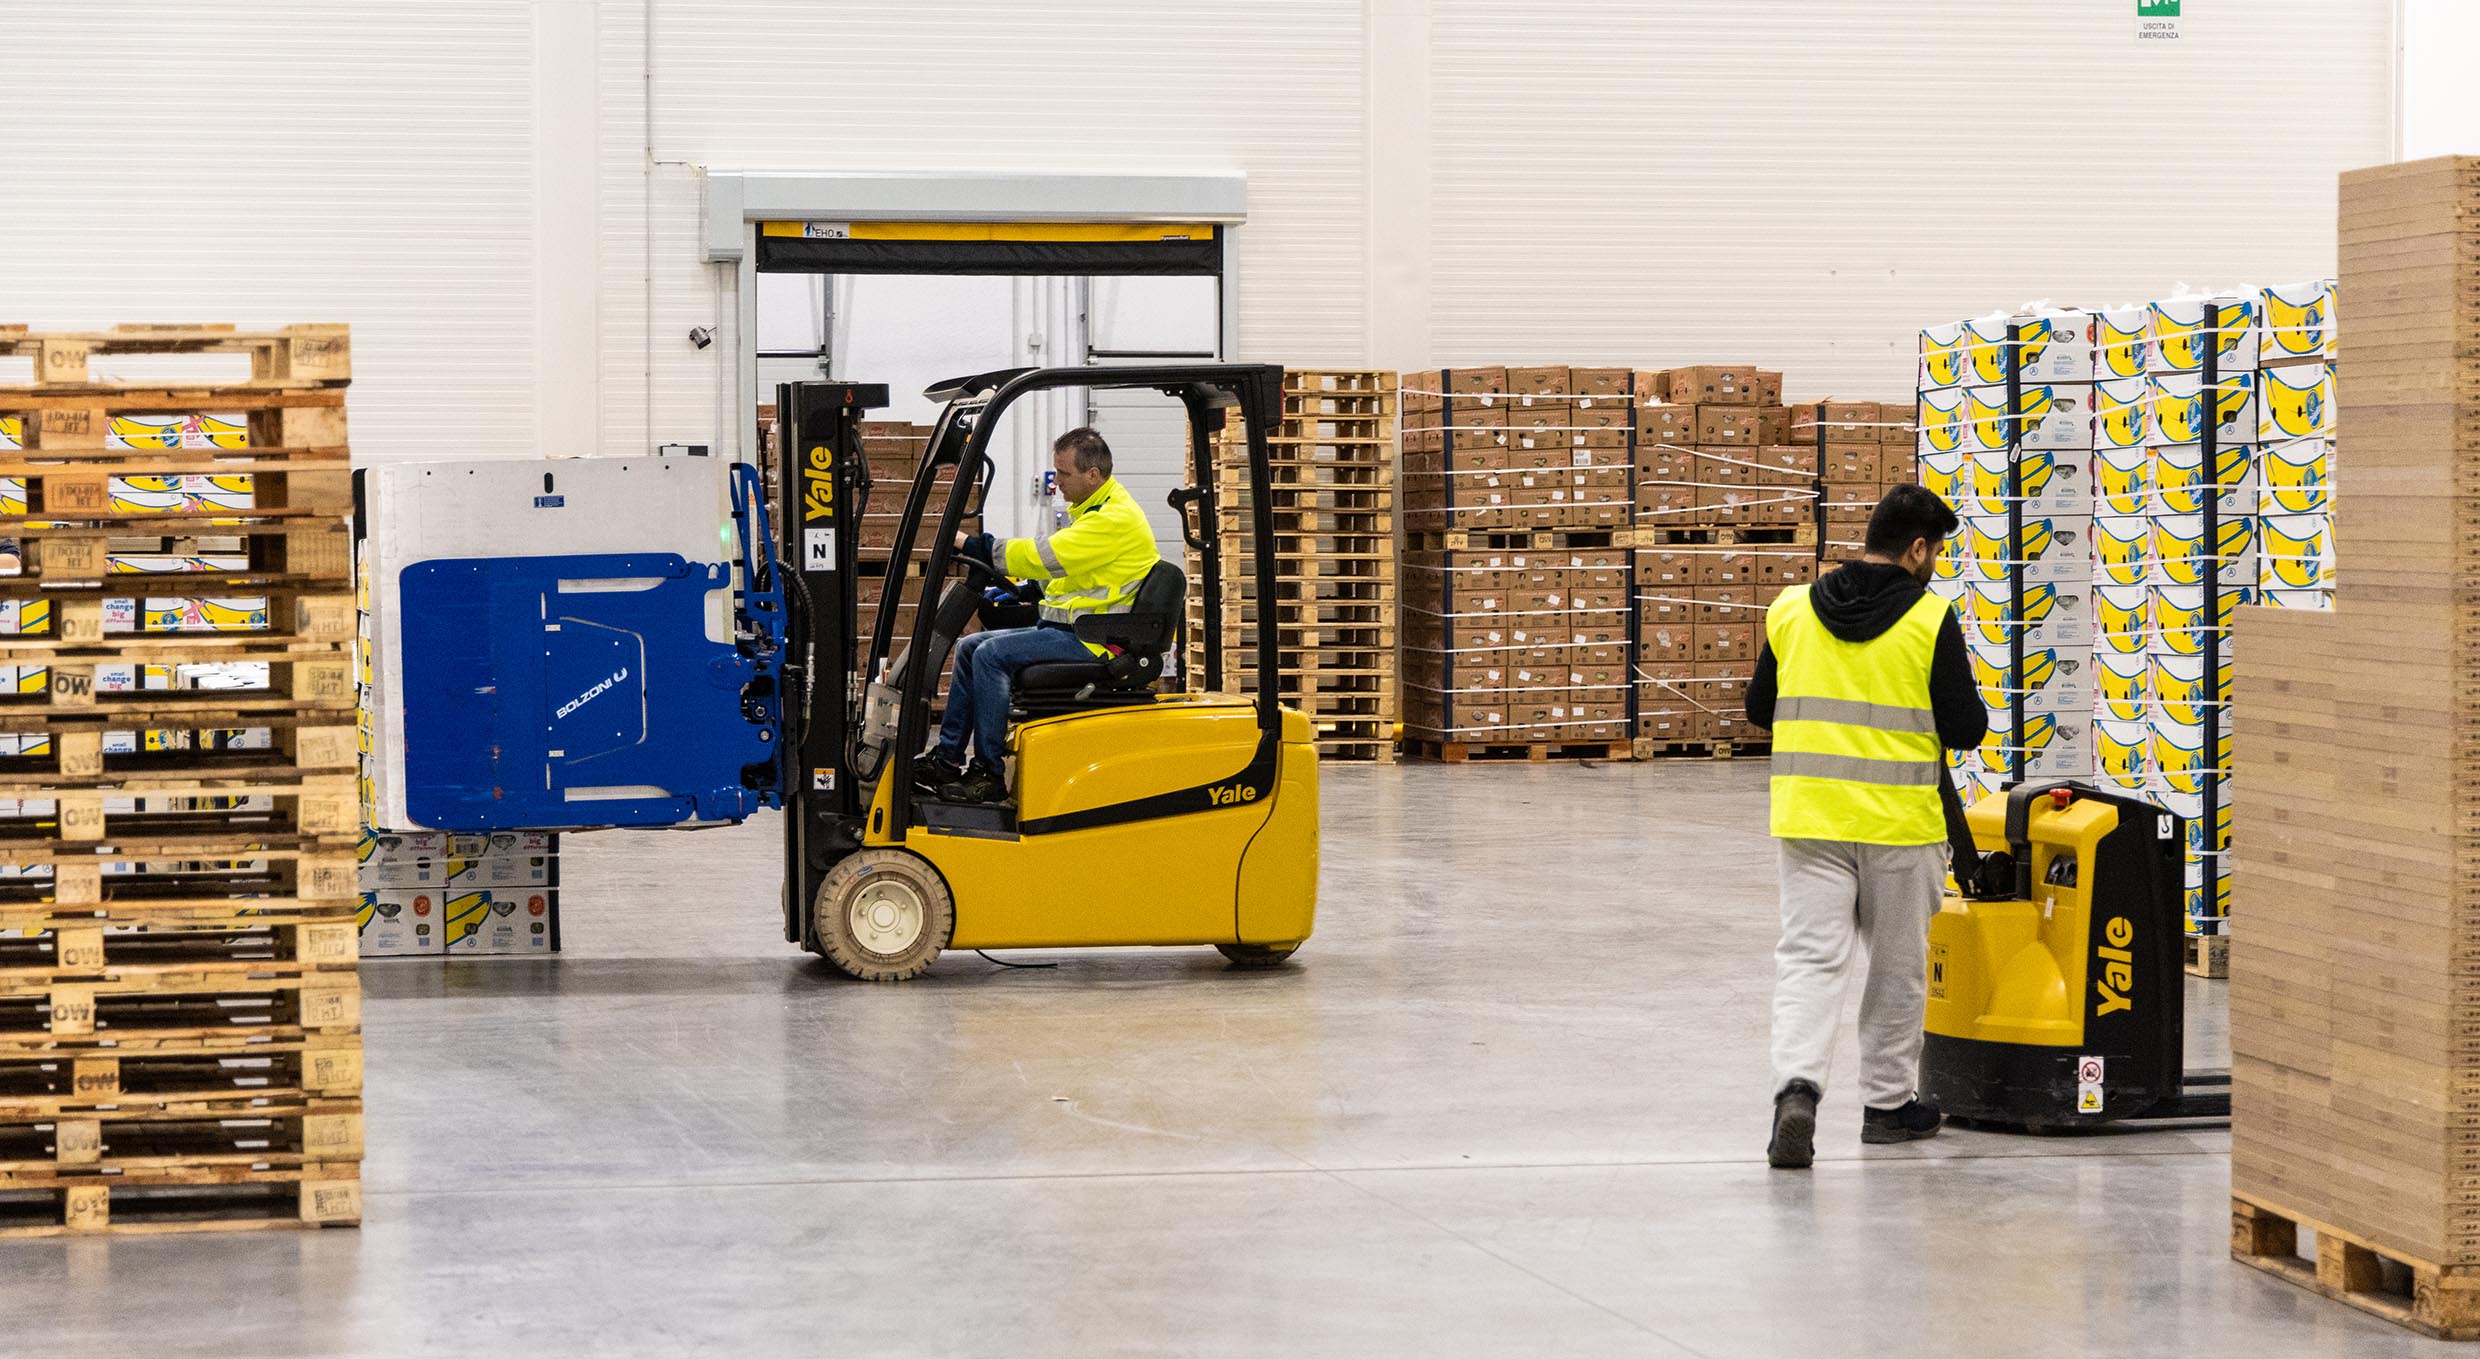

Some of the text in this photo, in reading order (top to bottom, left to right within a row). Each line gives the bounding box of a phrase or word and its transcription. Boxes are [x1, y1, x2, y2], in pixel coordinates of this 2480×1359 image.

[804, 446, 833, 521] Yale
[813, 544, 826, 559] N
[106, 603, 134, 611] change
[112, 611, 125, 619] big
[62, 619, 99, 637] OW
[55, 676, 91, 696] OW
[103, 676, 131, 684] change
[556, 678, 613, 720] BOLZONI
[1208, 784, 1256, 805] Yale
[1934, 962, 1942, 982] N
[2097, 916, 2133, 1017] Yale
